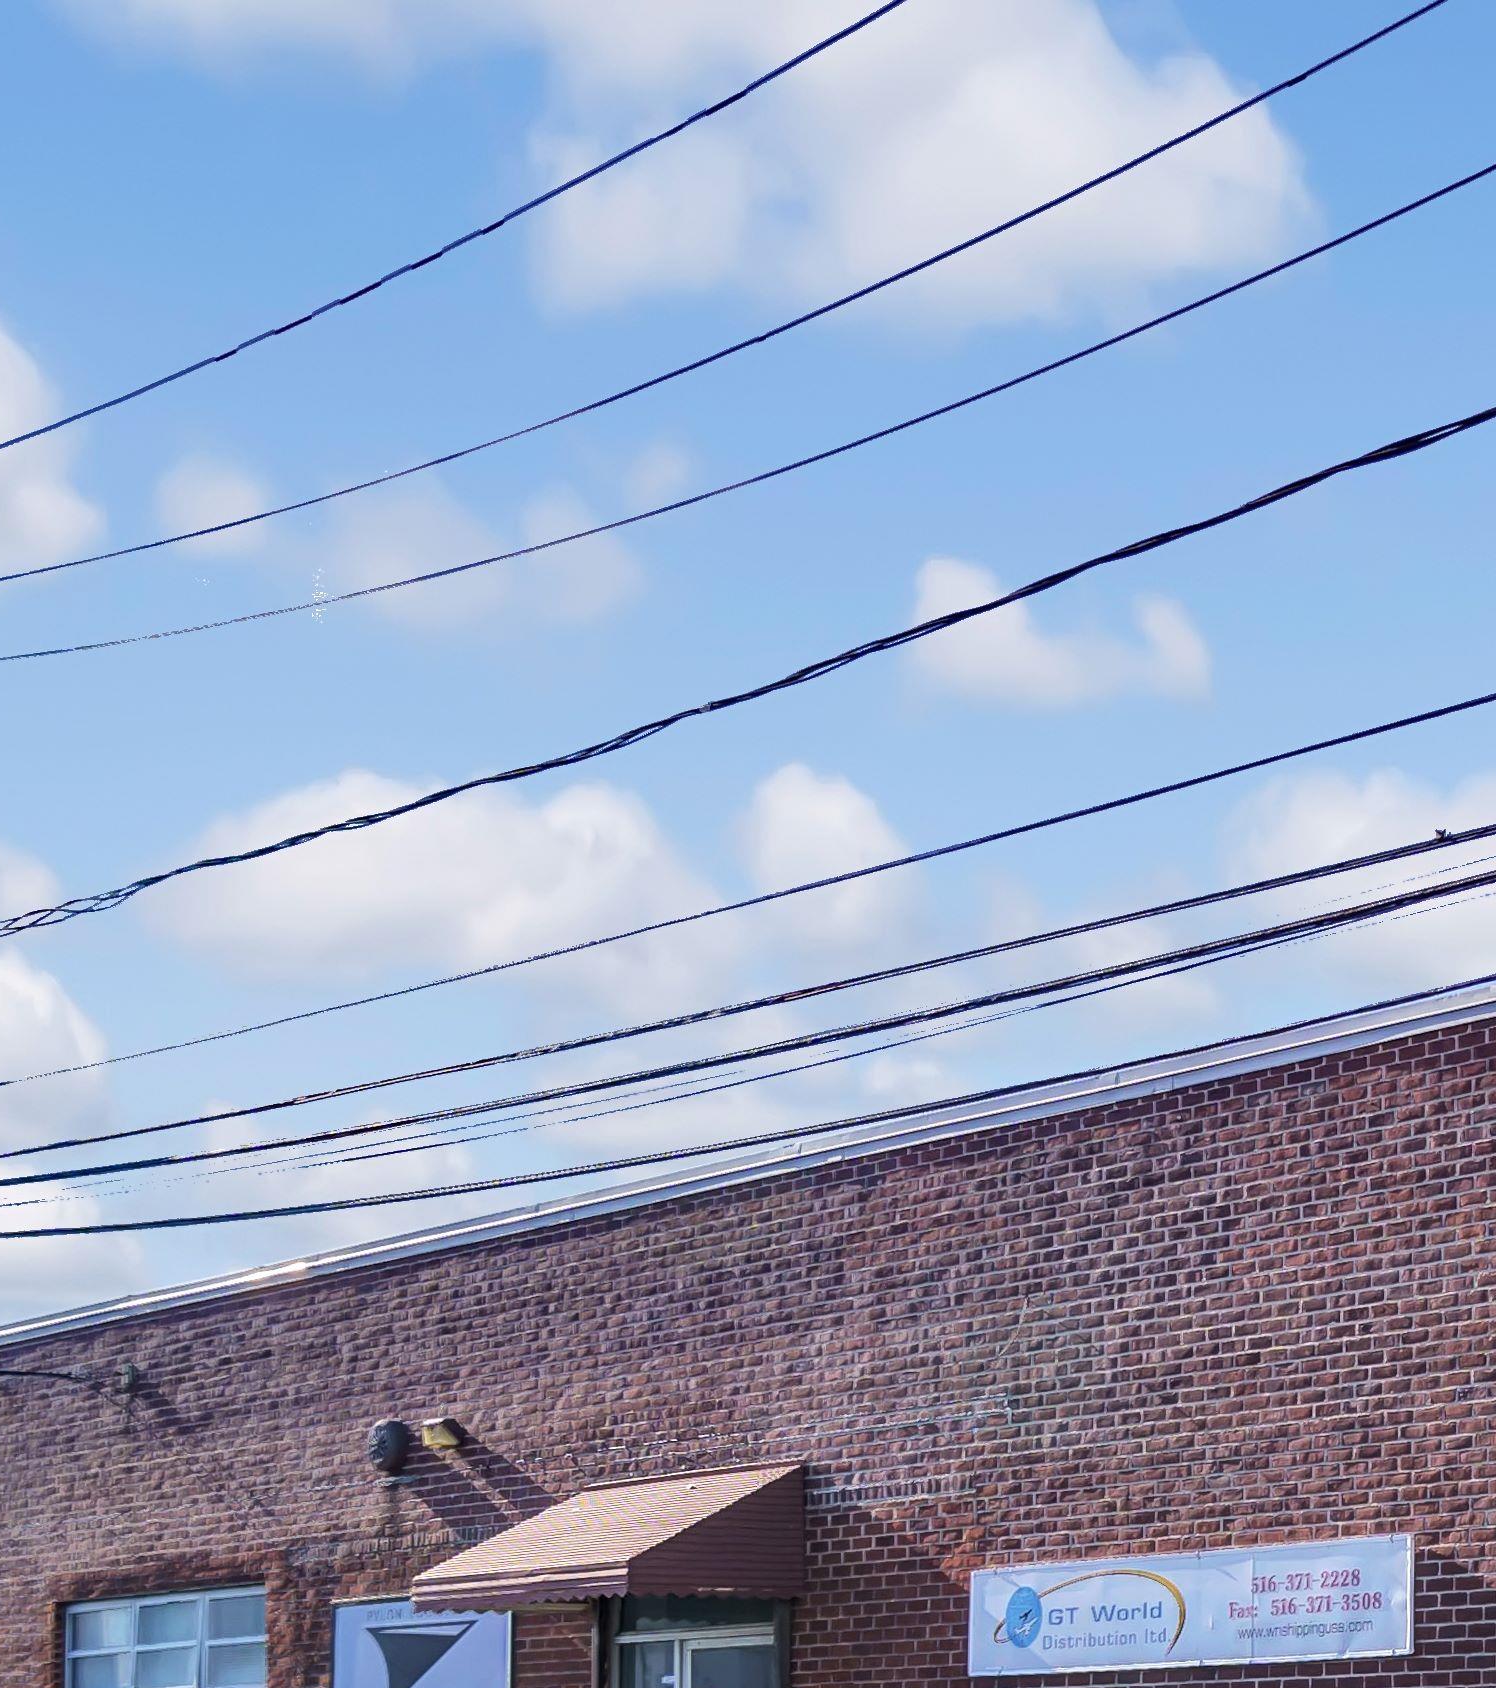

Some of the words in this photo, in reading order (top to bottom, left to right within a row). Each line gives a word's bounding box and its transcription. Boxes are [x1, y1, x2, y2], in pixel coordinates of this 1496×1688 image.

[1251, 1569, 1361, 1594] 516-371-2228
[1048, 1607, 1079, 1626] GT
[1091, 1601, 1162, 1622] World
[1228, 1602, 1258, 1620] Fax:
[1271, 1592, 1383, 1616] 516-371-3508
[1043, 1631, 1137, 1650] Distribution
[1145, 1627, 1171, 1644] ltd.
